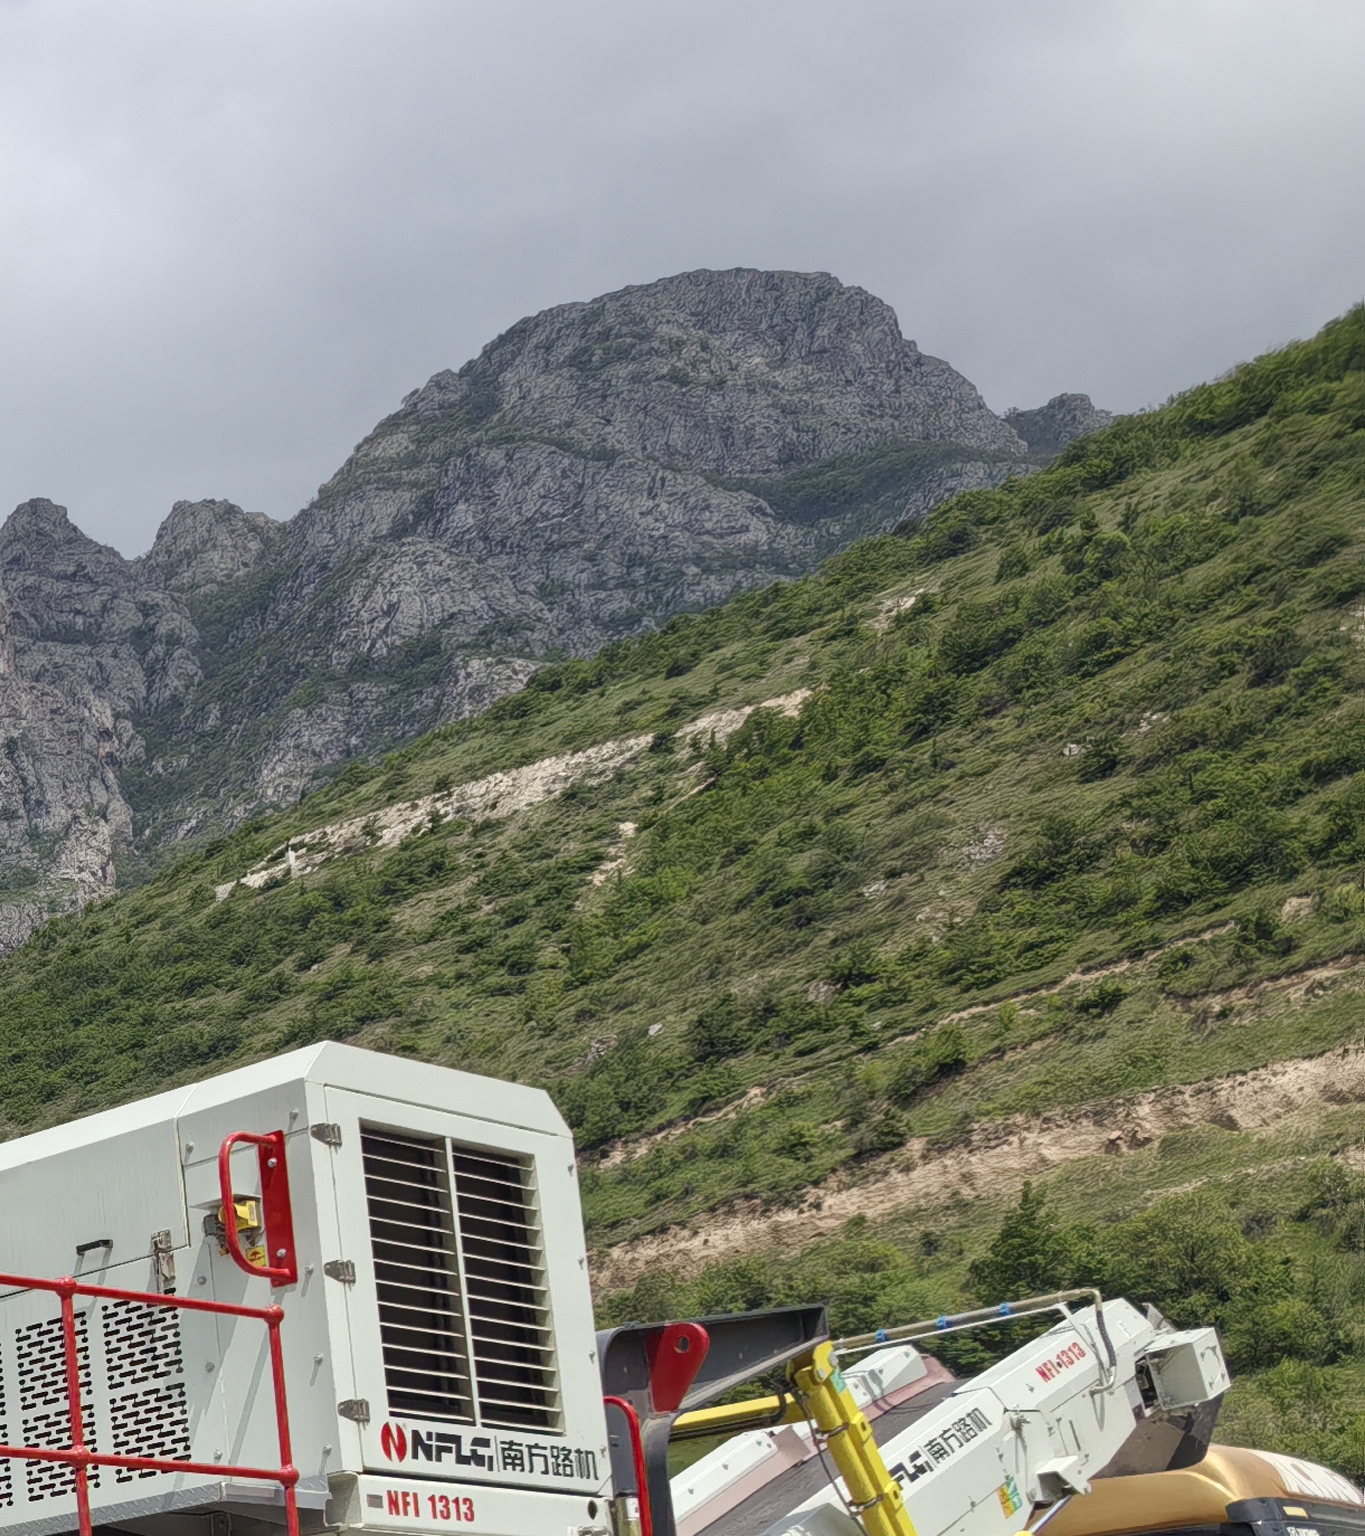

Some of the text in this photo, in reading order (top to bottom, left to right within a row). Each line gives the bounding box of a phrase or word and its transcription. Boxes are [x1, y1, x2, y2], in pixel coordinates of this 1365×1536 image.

[411, 1429, 494, 1472] NFLG
[500, 1439, 599, 1481] 南方路机
[925, 1406, 993, 1465] 南方路机
[386, 1489, 475, 1523] NFI 1313
